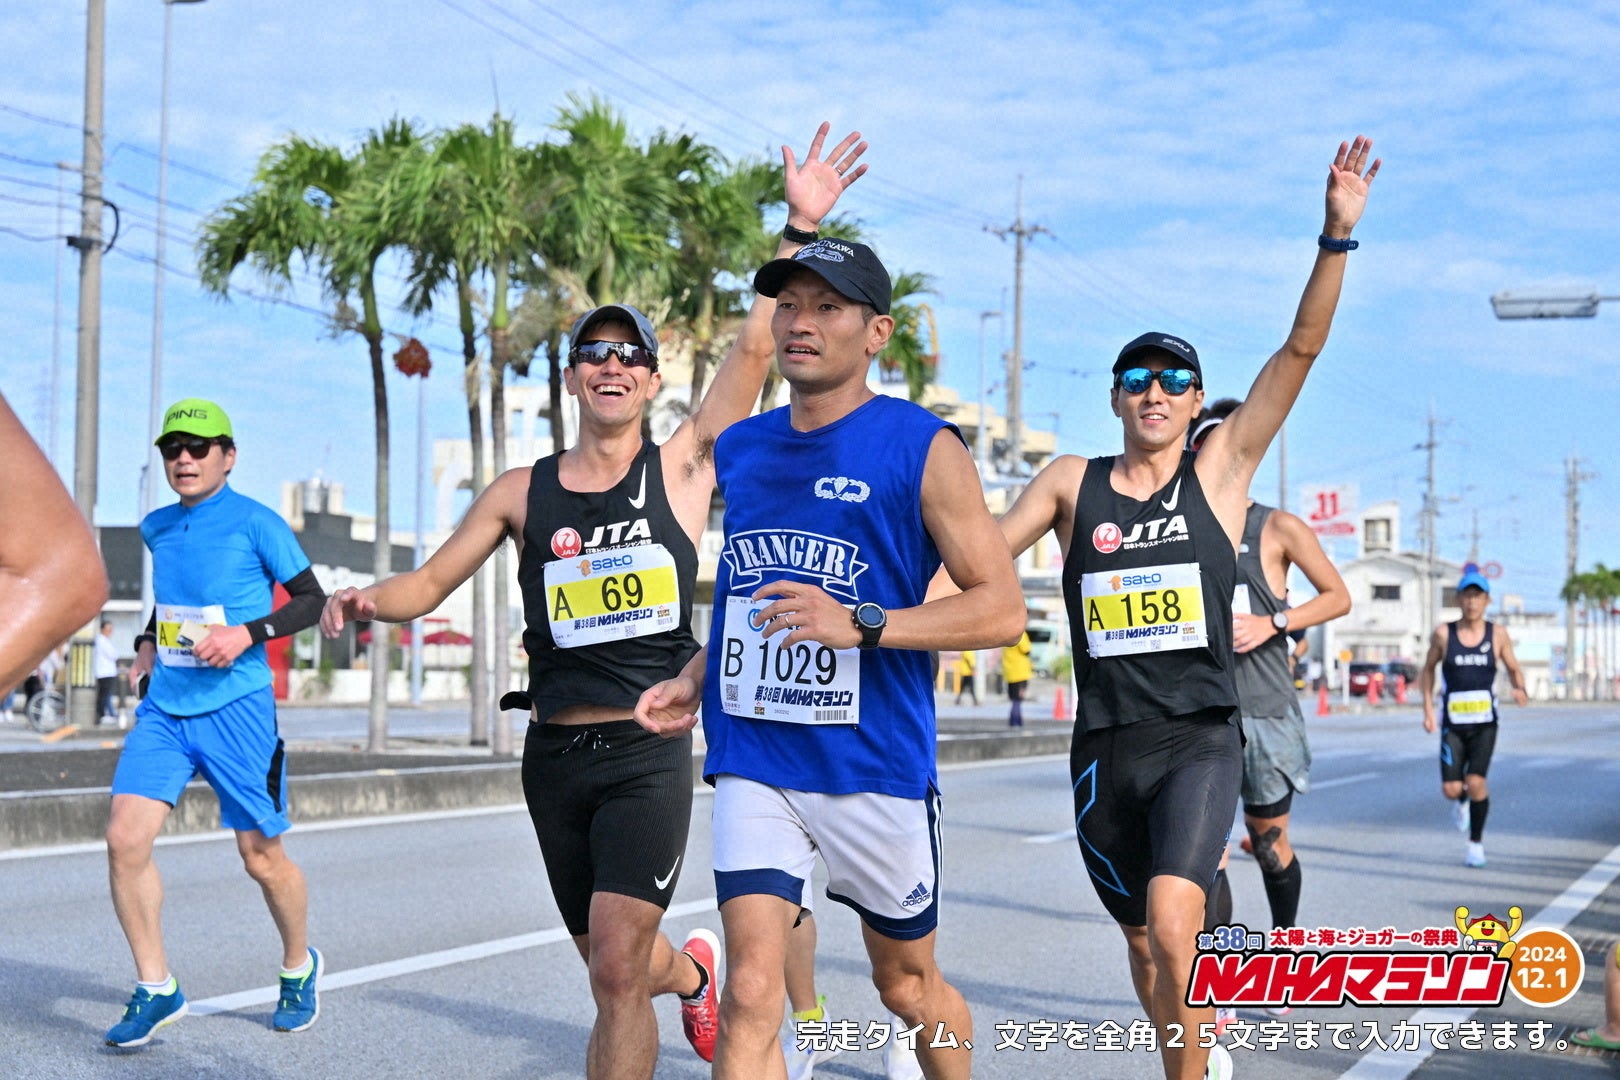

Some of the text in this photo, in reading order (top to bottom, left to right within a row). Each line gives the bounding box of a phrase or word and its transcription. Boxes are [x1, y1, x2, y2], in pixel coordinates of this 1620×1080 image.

[166, 408, 208, 425] PING
[583, 518, 652, 548] JTA
[1122, 514, 1189, 543] JTA
[736, 535, 845, 577] RANGER
[553, 572, 643, 621] A 69
[1088, 589, 1181, 631] A 158
[159, 622, 168, 646] A
[724, 637, 837, 686] B 1029
[902, 892, 930, 907] adidas
